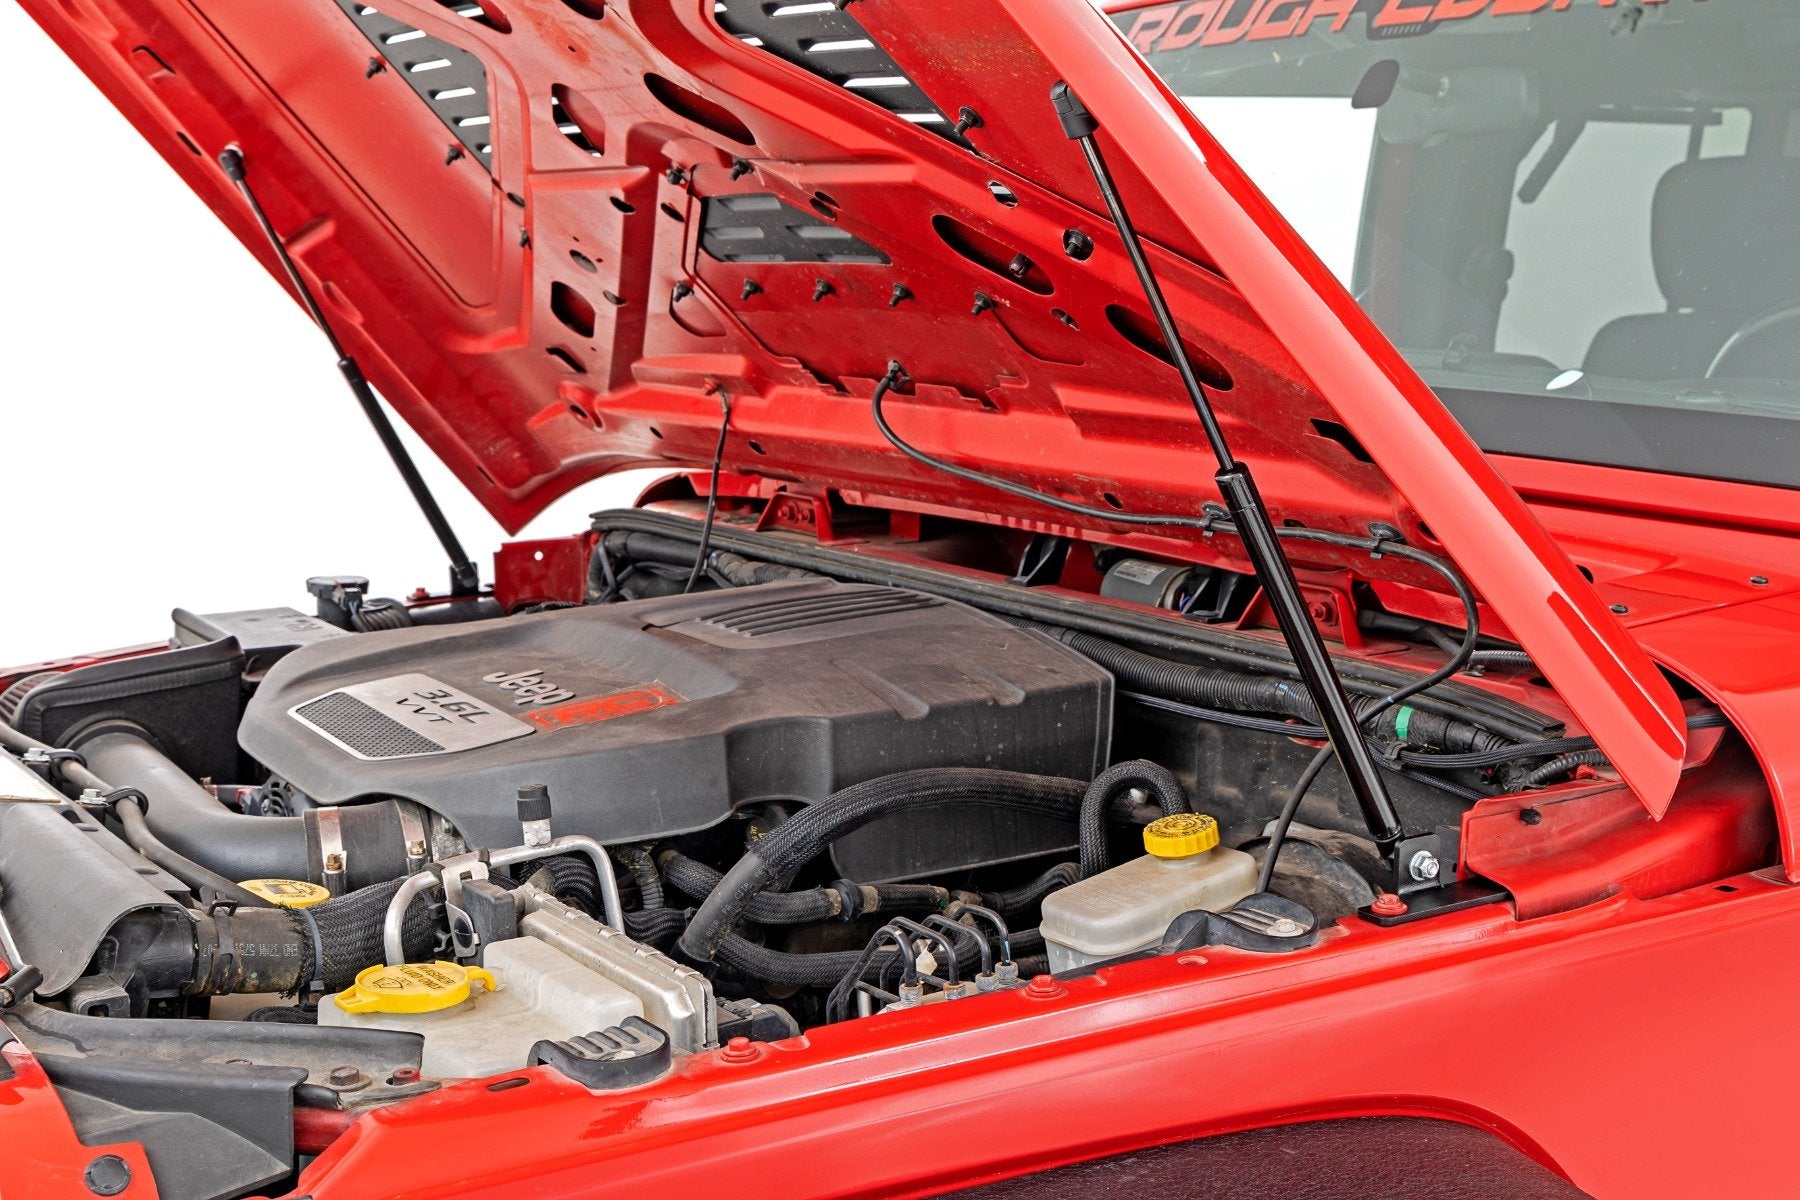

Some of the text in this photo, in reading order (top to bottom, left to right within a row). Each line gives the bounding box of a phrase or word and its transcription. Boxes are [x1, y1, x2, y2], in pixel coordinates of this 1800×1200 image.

[1128, 0, 1360, 55] ROUGH
[482, 669, 576, 706] Jeep
[396, 698, 454, 723] VVT
[413, 689, 490, 723] 3.6L
